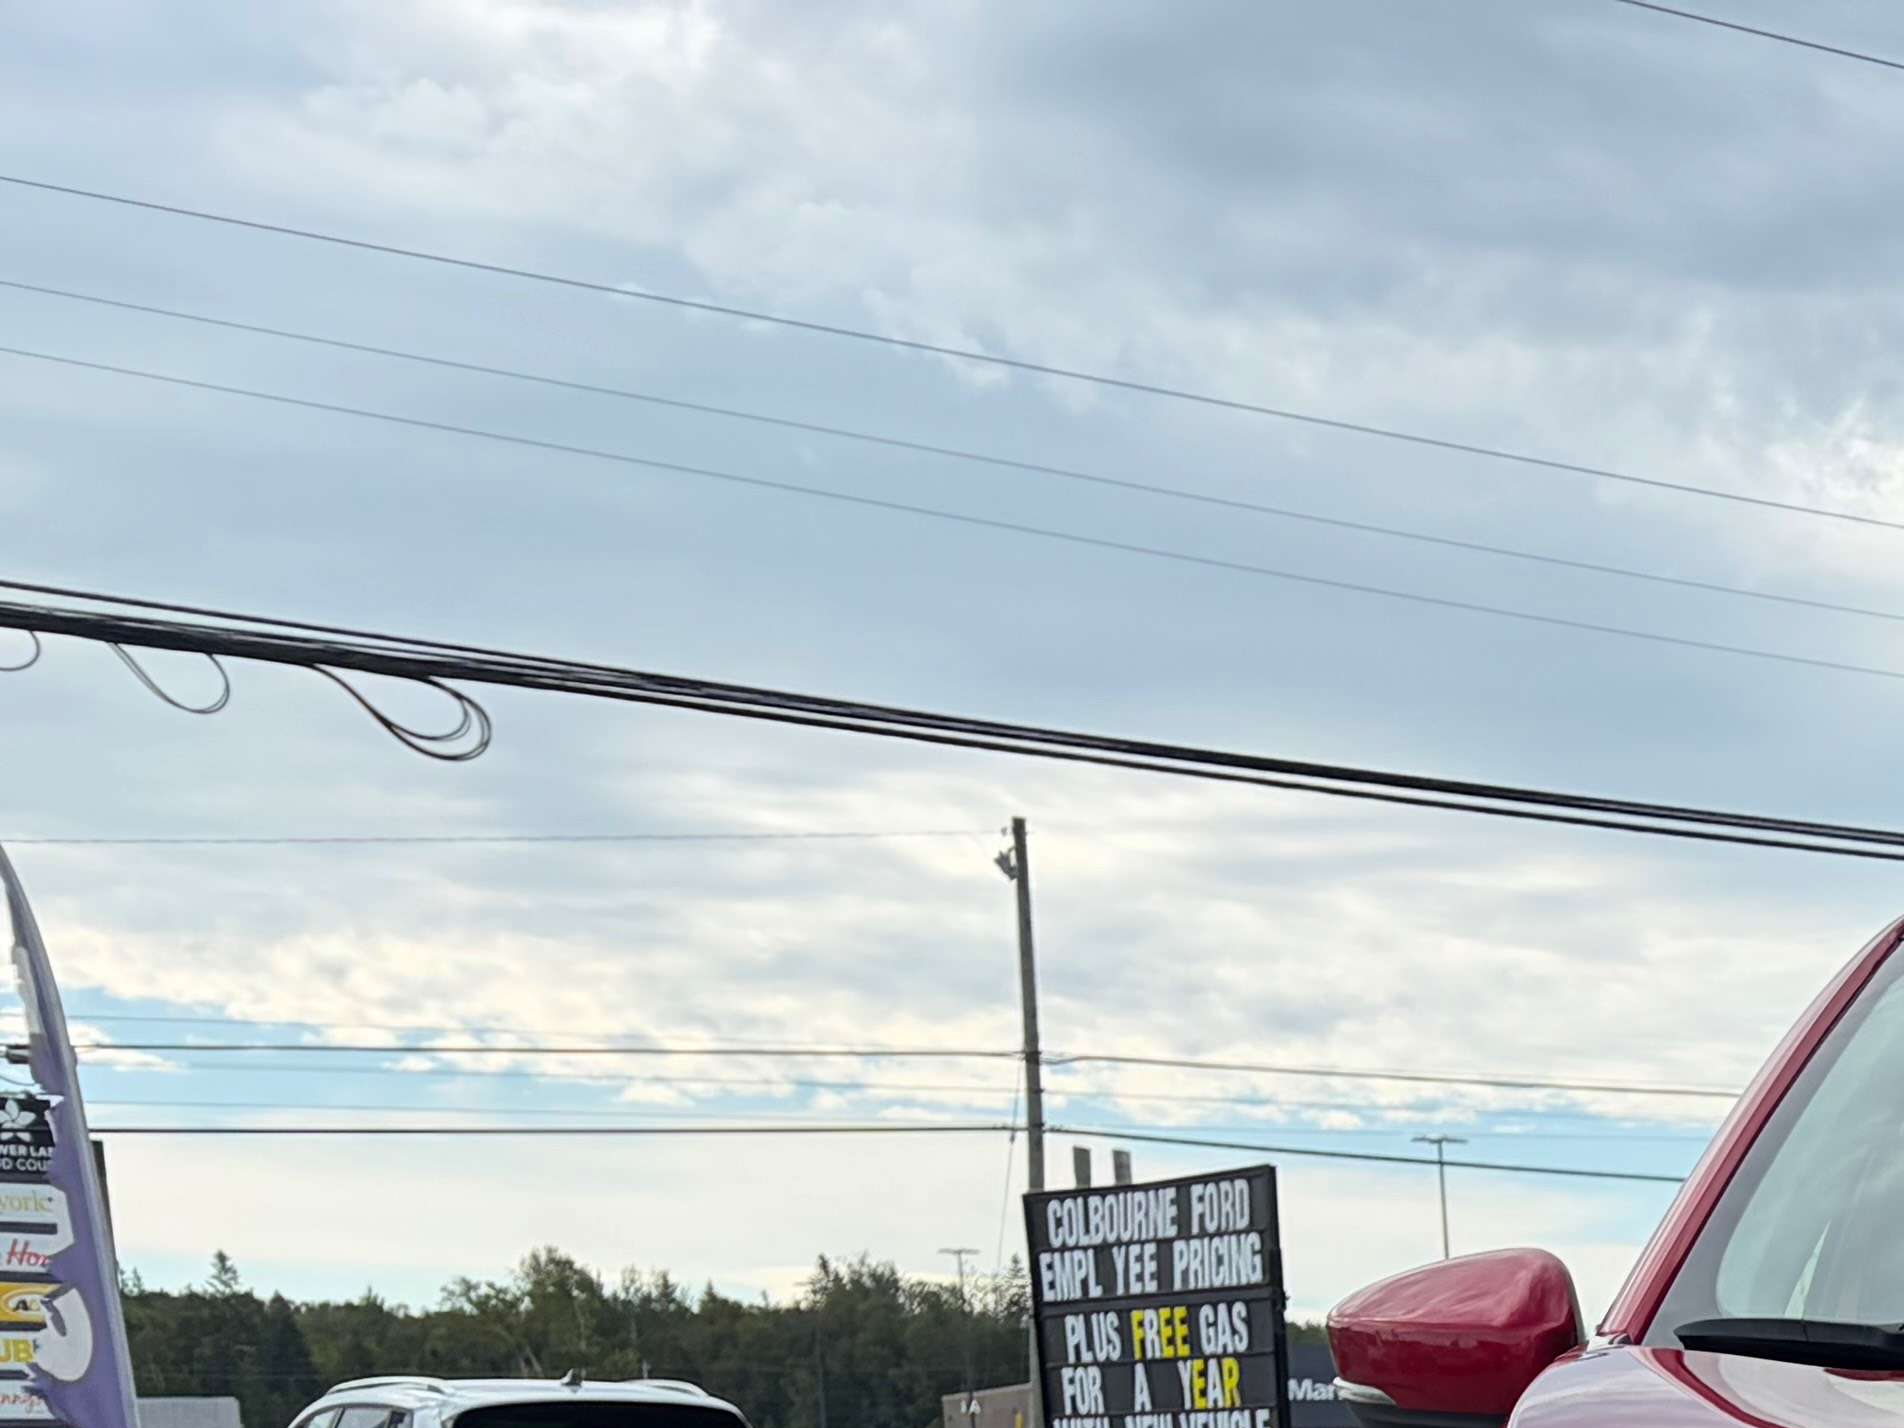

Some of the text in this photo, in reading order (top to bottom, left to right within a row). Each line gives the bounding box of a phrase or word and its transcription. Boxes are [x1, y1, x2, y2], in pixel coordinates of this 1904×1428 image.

[1047, 1179, 1250, 1248] COLBOURNE FORD
[1172, 1232, 1264, 1291] PRICING
[1065, 1301, 1248, 1364] PLUS FREE GAS
[1061, 1357, 1240, 1415] FOR A YEAR
[1288, 1378, 1336, 1401] Mar
